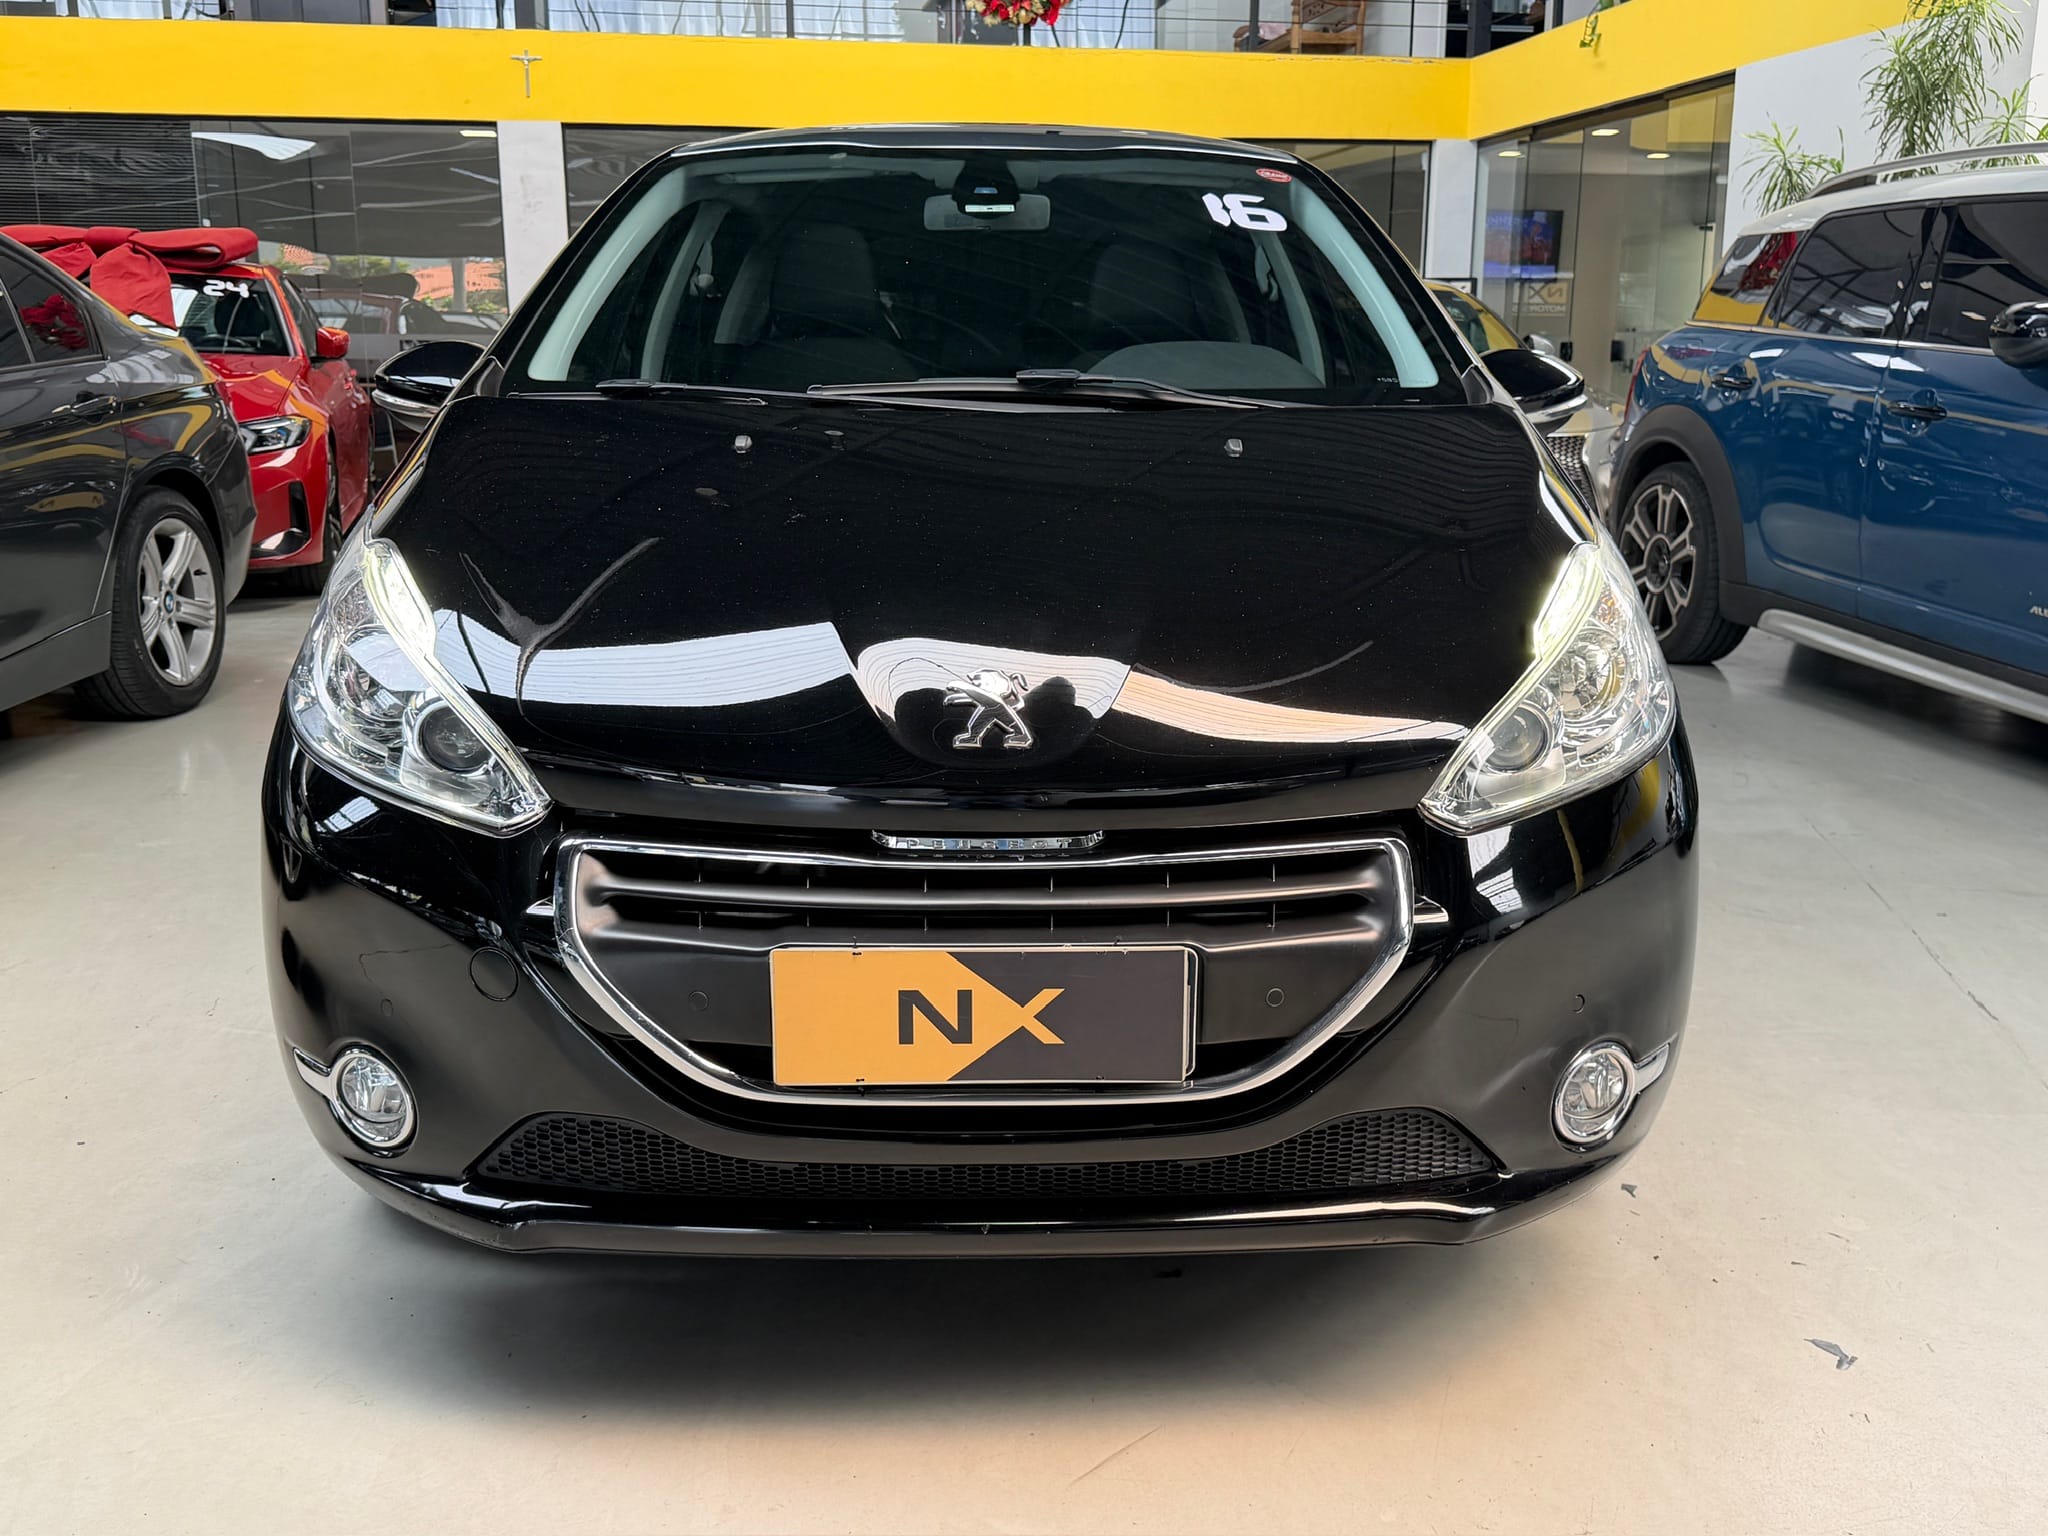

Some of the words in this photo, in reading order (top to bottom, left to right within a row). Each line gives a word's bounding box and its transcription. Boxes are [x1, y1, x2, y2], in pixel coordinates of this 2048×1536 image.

[1202, 193, 1287, 231] 16
[203, 280, 249, 298] 24
[906, 836, 1073, 850] PEUGEOT
[898, 988, 1066, 1044] NX
